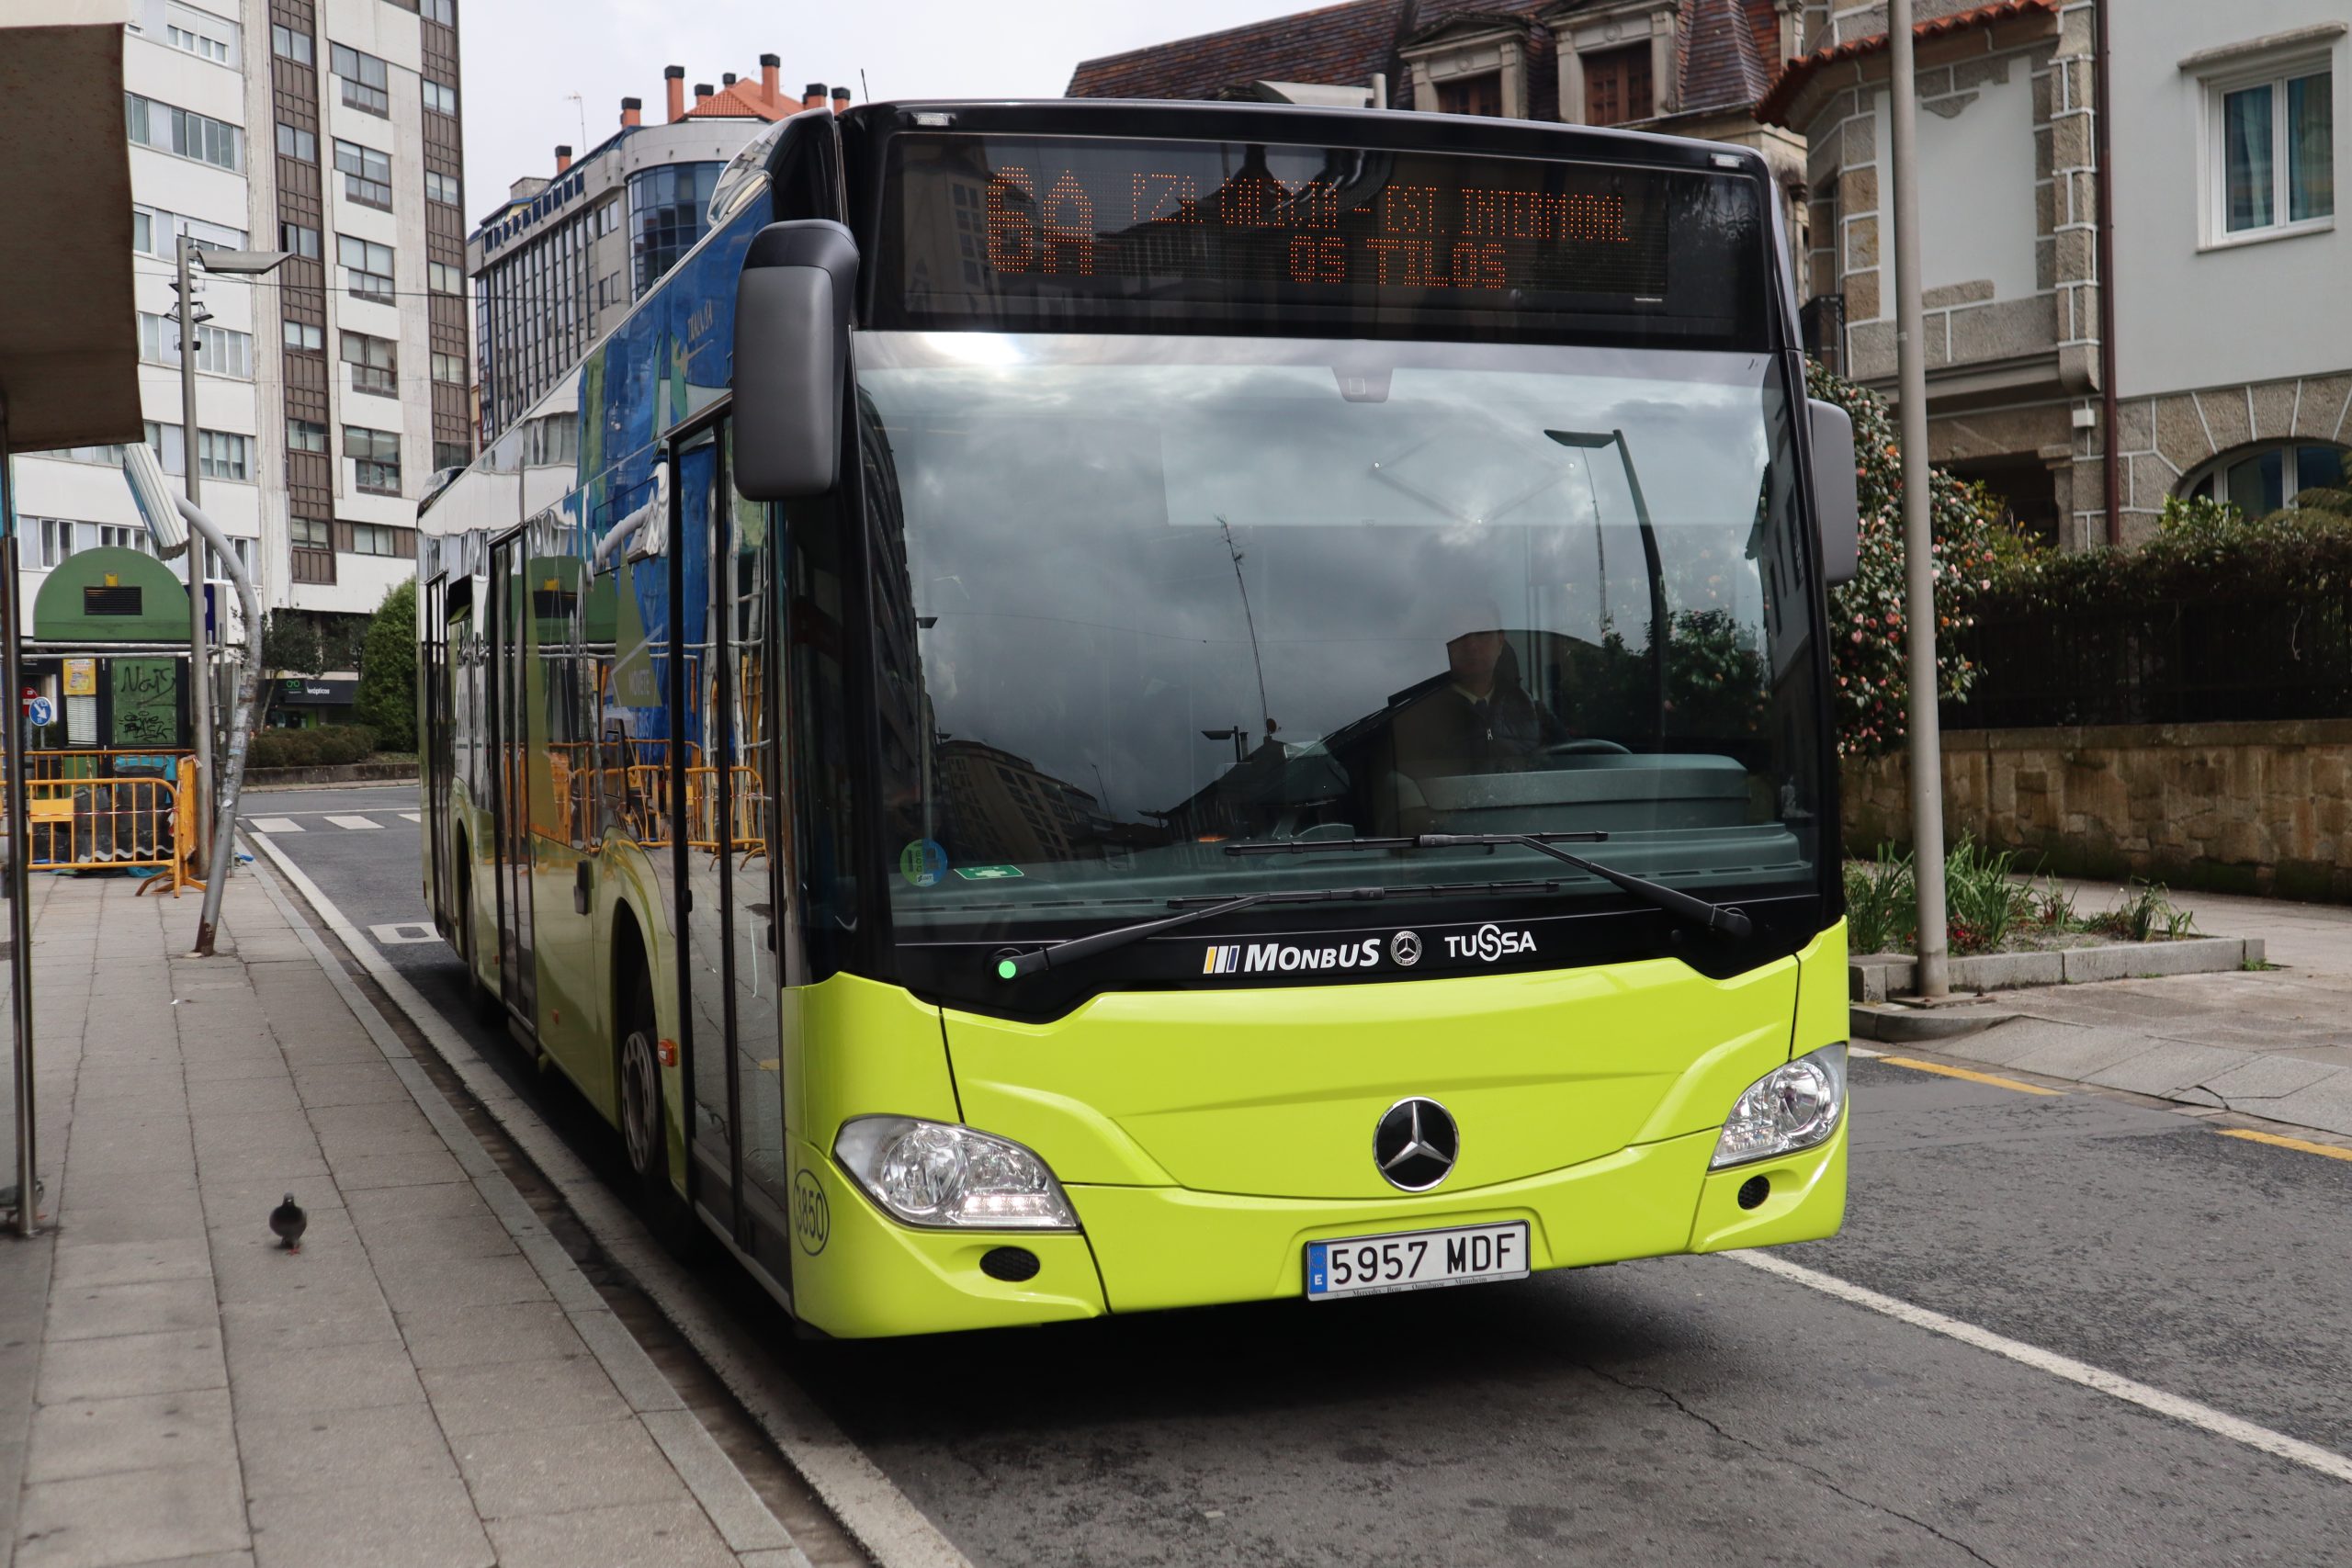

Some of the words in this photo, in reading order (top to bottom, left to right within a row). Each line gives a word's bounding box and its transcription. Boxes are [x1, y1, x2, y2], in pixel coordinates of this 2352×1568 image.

[988, 166, 1092, 275] 6A
[1387, 186, 1444, 234] EST.
[1291, 235, 1345, 284] OS
[1366, 239, 1506, 288] TILOS
[1244, 938, 1380, 973] MONBUS
[1444, 924, 1537, 962] TUSSA
[796, 1184, 824, 1241] 3850
[1314, 1274, 1322, 1285] E
[1331, 1240, 1429, 1285] 5957
[1446, 1233, 1516, 1274] MDF
